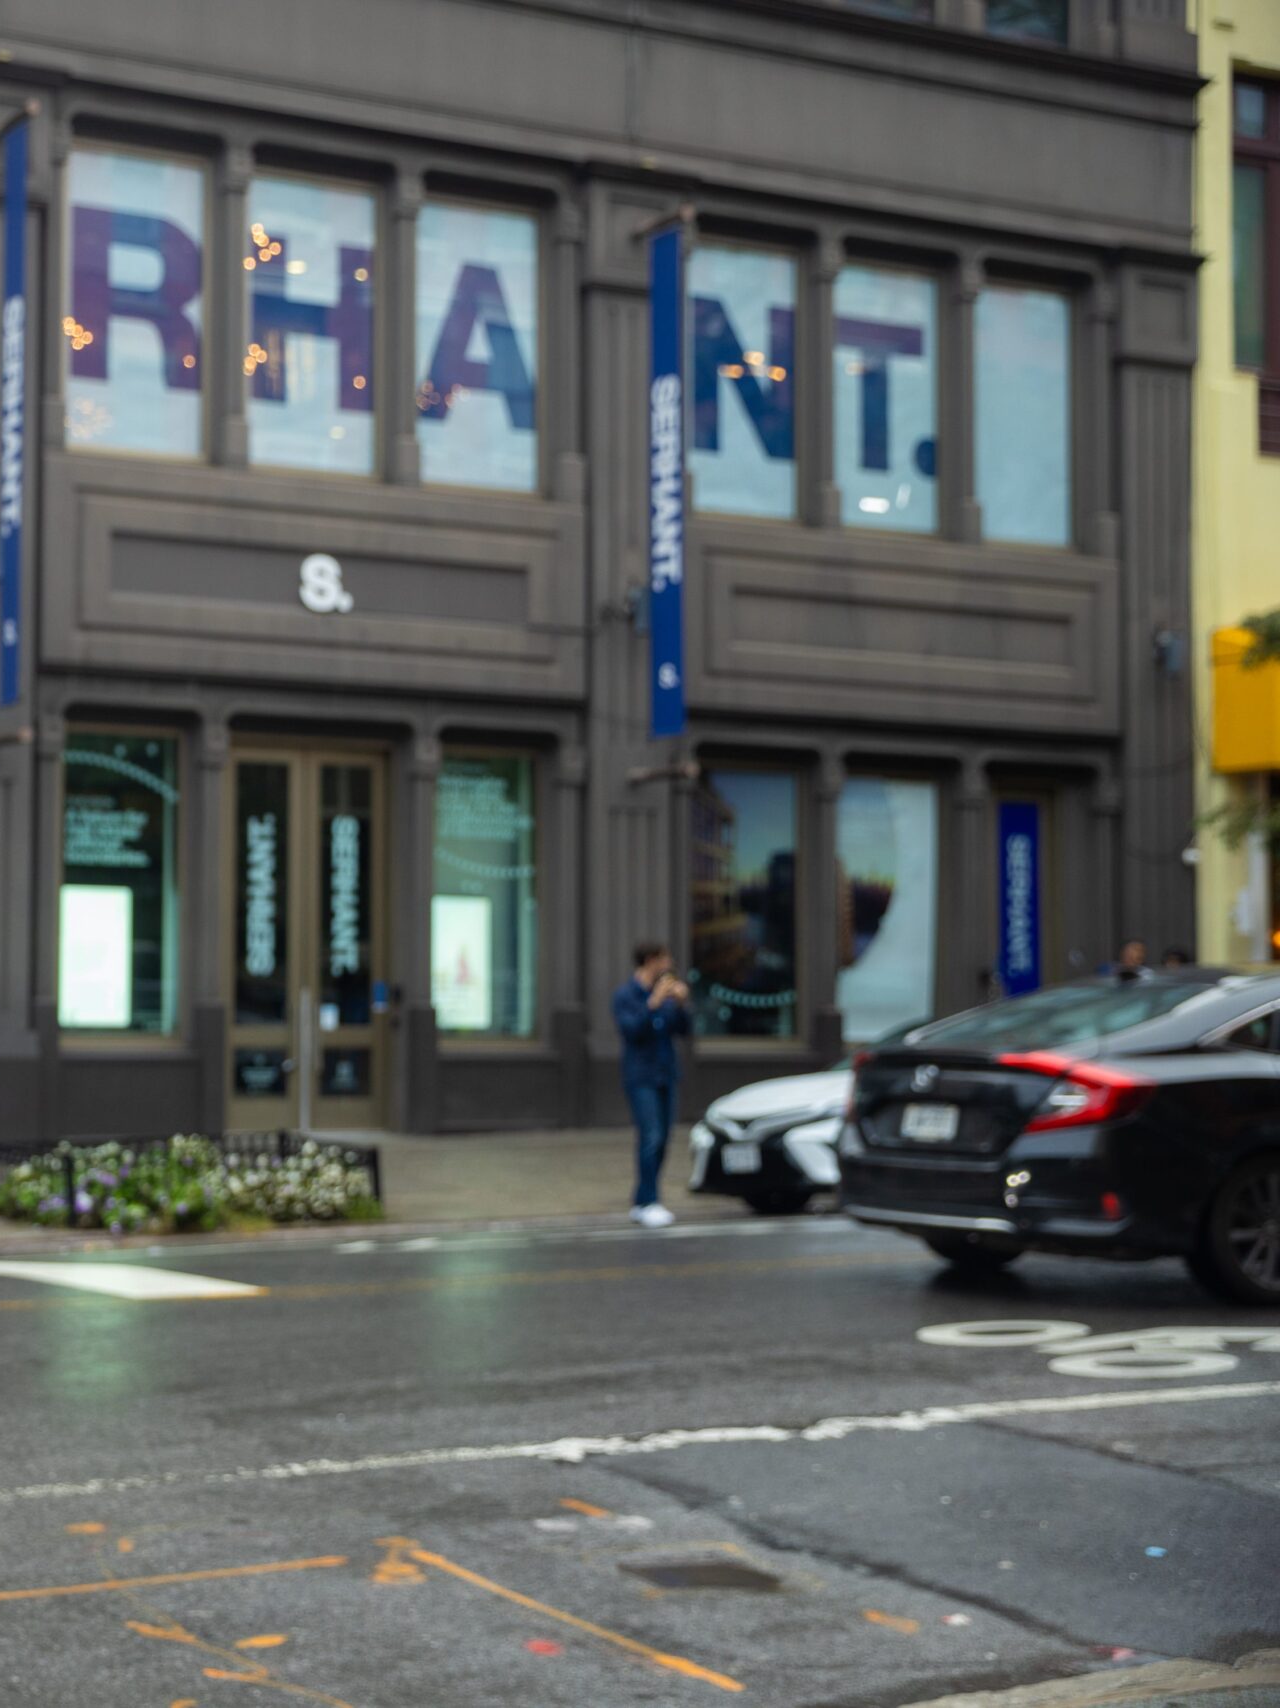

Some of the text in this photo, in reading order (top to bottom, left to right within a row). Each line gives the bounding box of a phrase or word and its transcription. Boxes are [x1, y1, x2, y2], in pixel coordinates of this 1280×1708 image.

[1, 295, 26, 539] SERHANT.
[651, 373, 683, 593] SERHANT.
[298, 552, 354, 614] S.
[245, 812, 276, 976] SERHANT.
[330, 814, 360, 977] SERHANT.
